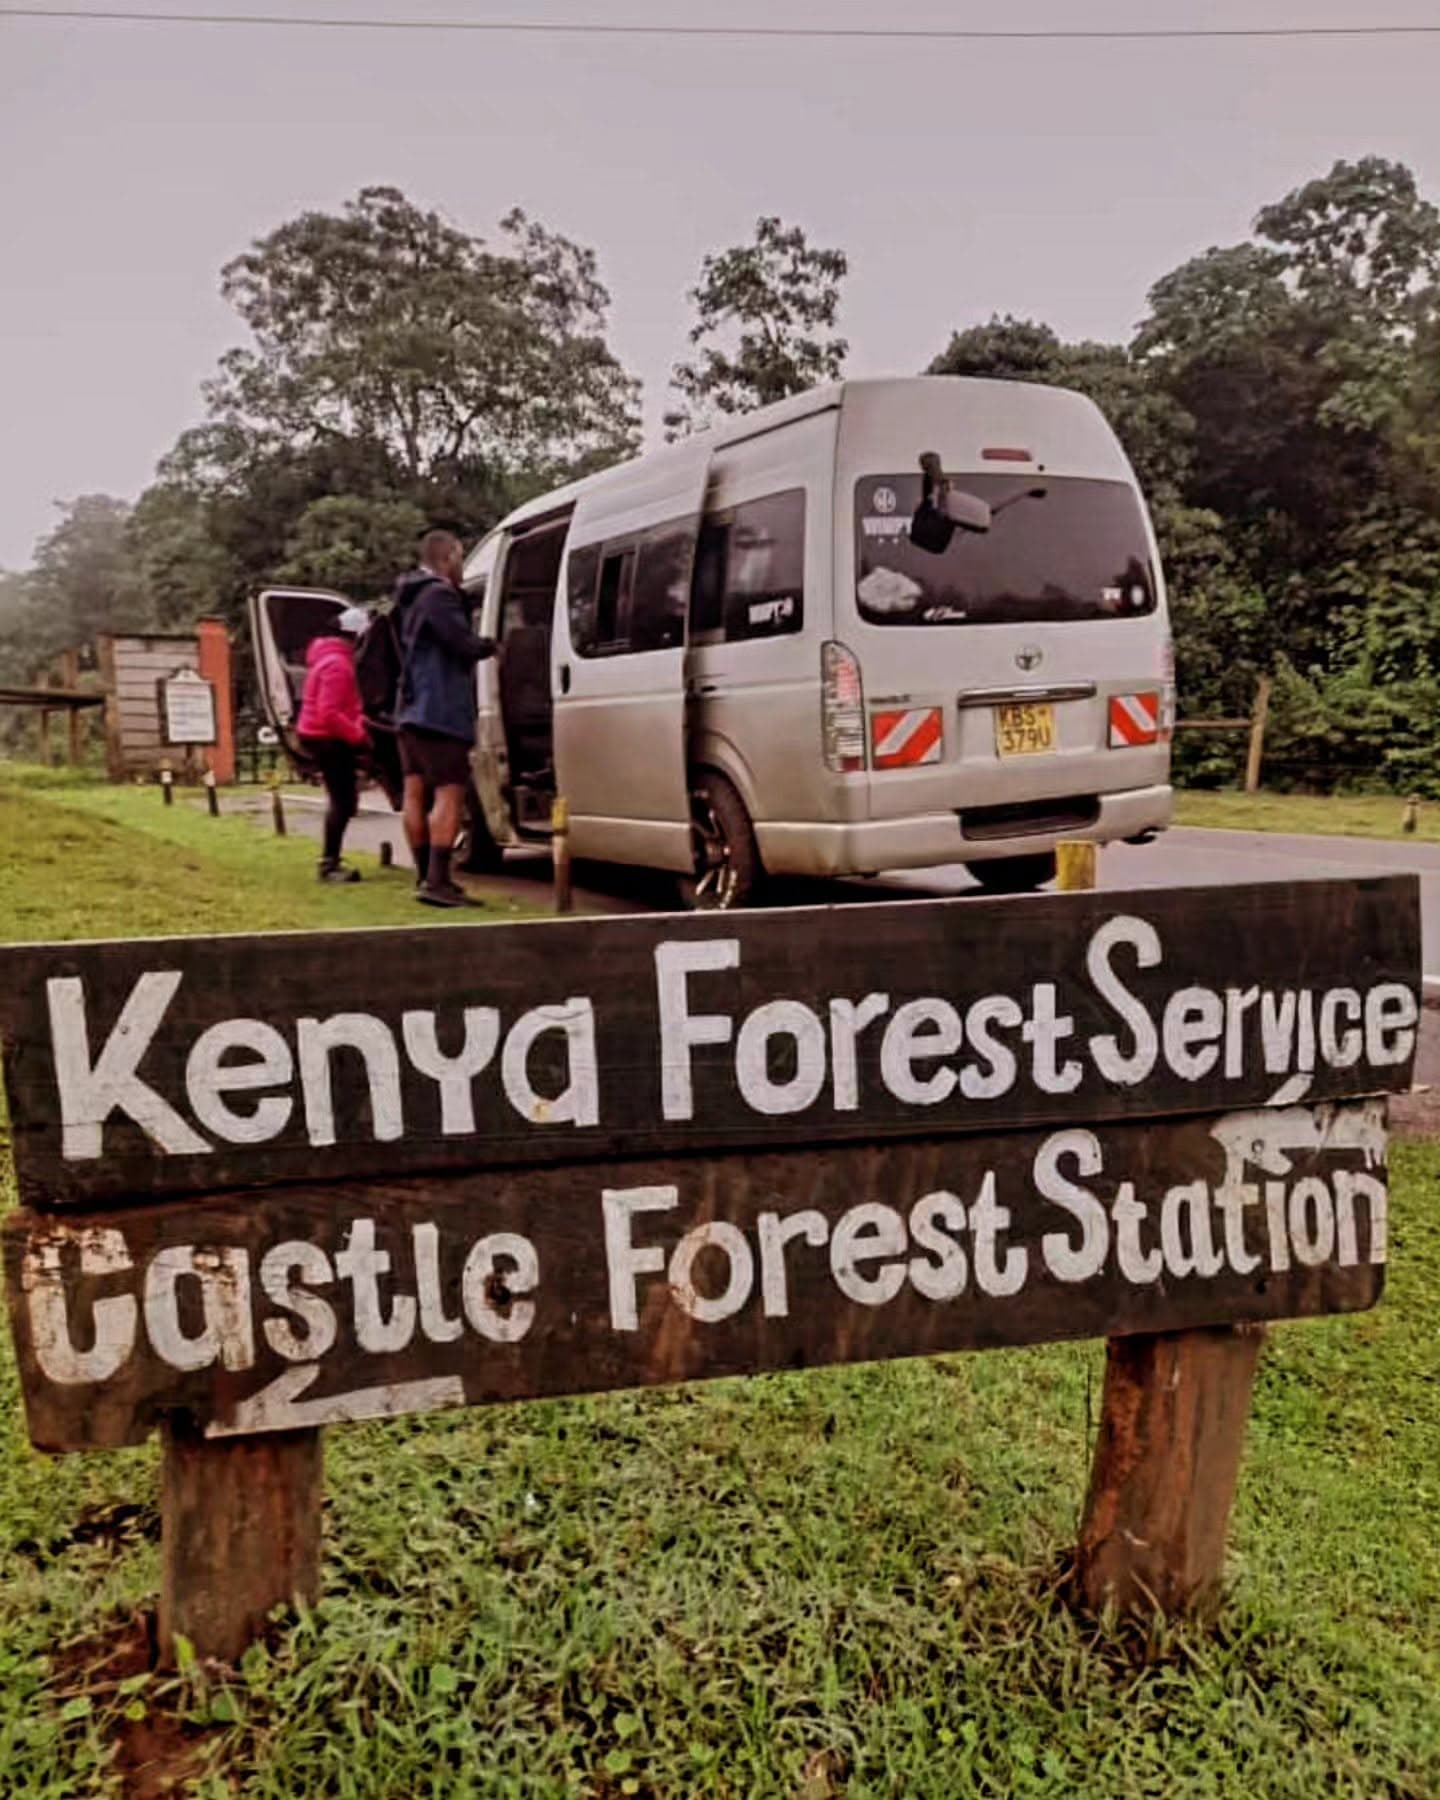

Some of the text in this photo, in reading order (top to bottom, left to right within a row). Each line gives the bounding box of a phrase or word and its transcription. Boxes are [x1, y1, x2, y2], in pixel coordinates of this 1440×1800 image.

[1000, 703, 1037, 727] KBS
[1003, 726, 1052, 751] 379U
[46, 914, 1418, 1160] Kenya Forest Service
[22, 1129, 1388, 1385] Castle Forest Station
